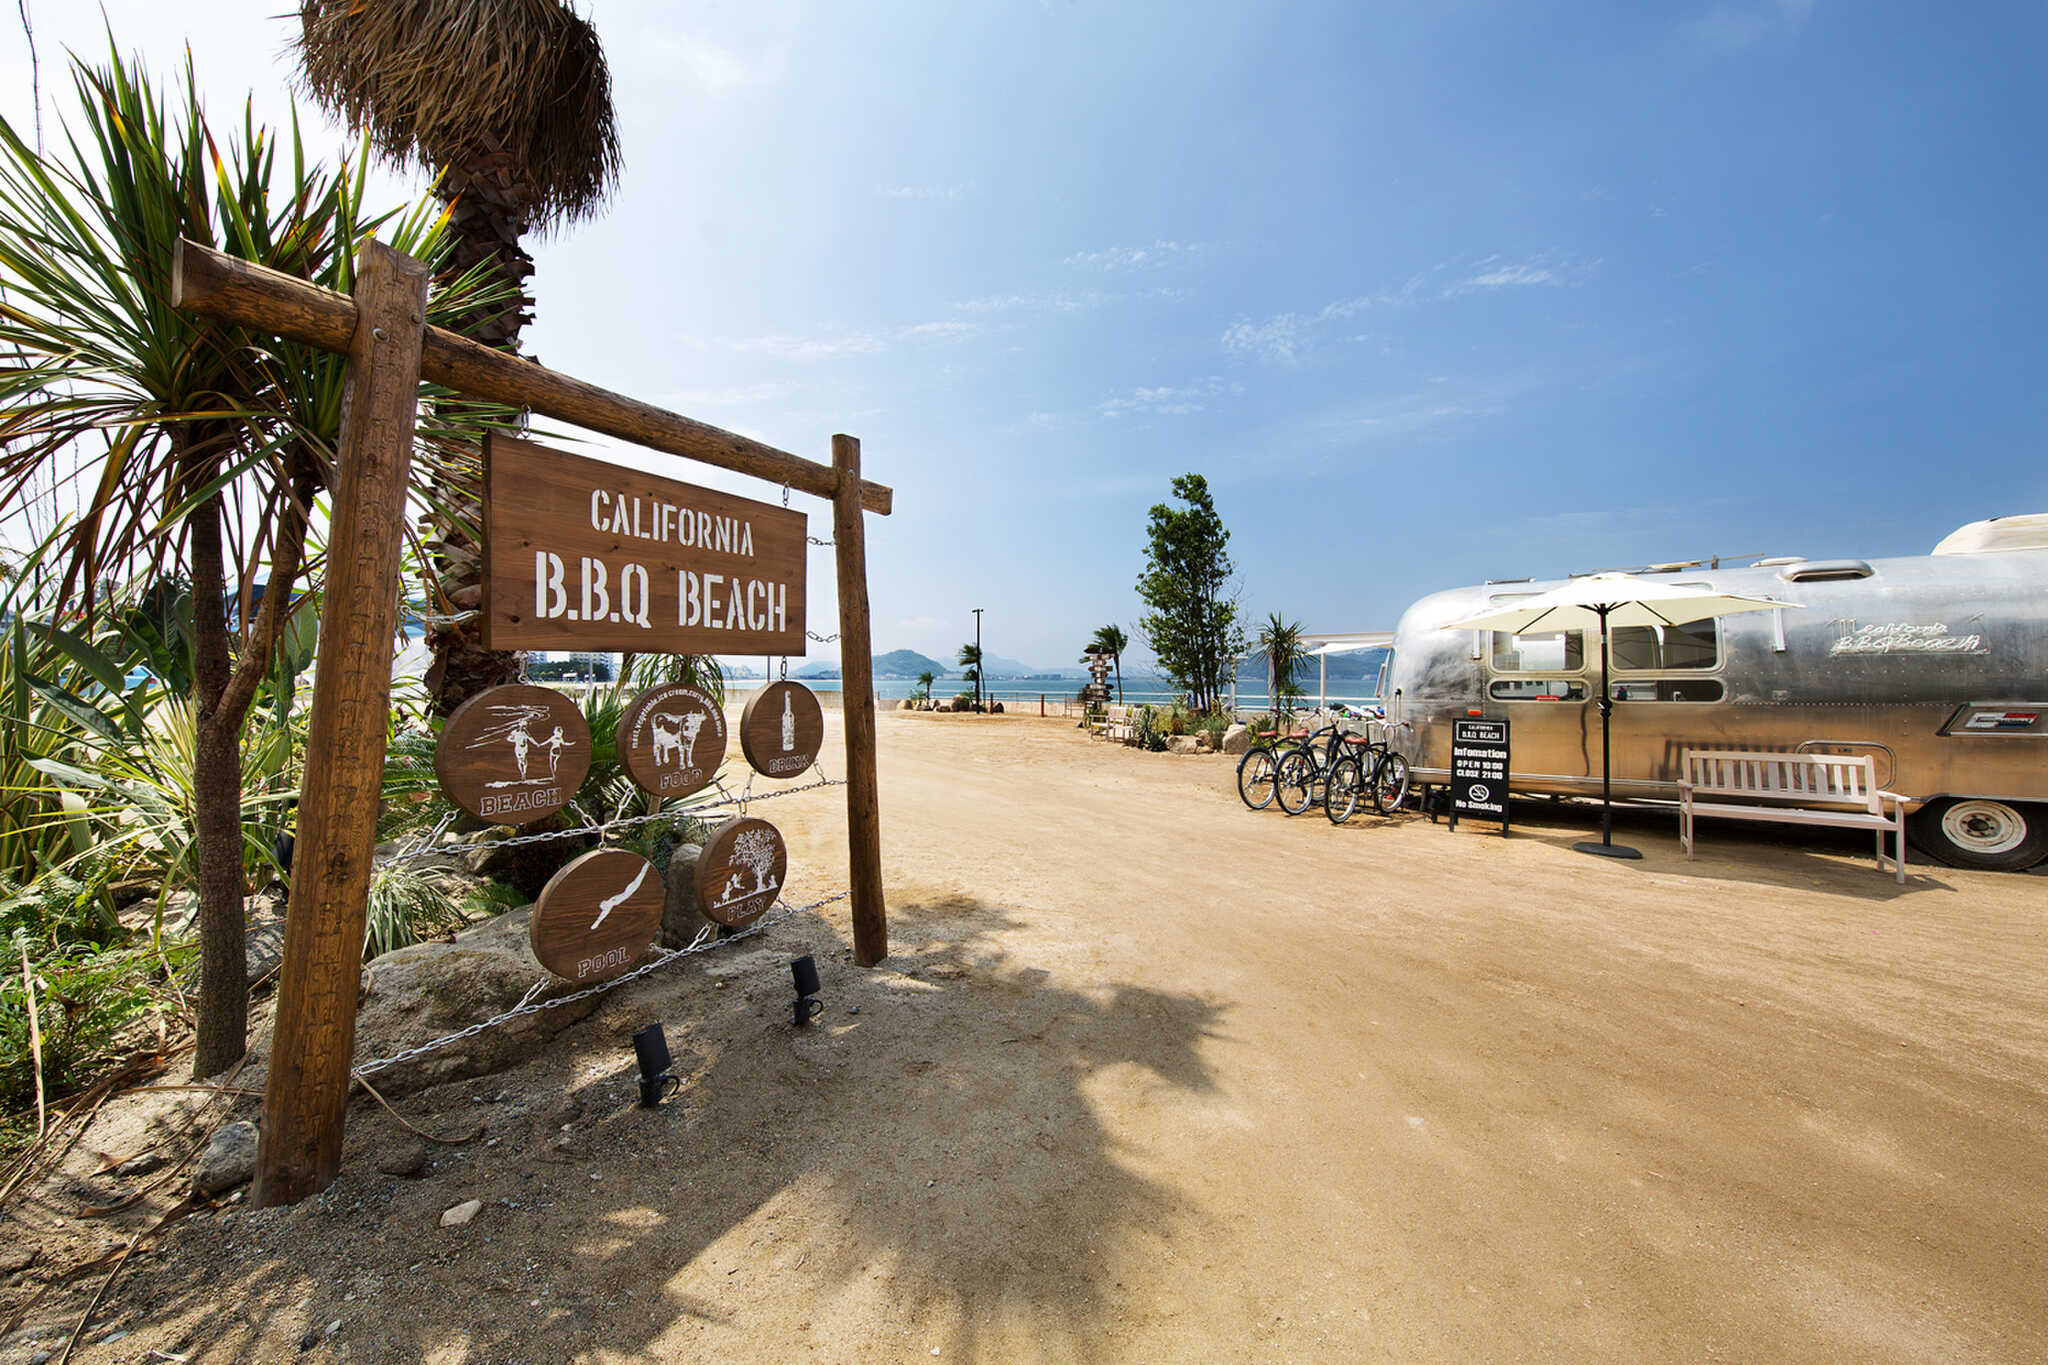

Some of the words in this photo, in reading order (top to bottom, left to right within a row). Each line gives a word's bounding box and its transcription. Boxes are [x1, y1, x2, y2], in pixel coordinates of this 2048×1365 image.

[591, 489, 754, 557] CALIFORNIA
[535, 551, 651, 628] B.B.Q
[678, 570, 786, 632] BEACH
[1479, 731, 1501, 740] BEACH
[769, 754, 810, 773] DRINK
[1456, 759, 1481, 769] OPEN
[1456, 769, 1480, 778] CLOSE
[660, 768, 703, 789] FOOD
[480, 787, 562, 816] BEACH
[1455, 800, 1467, 808] No
[1468, 801, 1503, 813] Smoking
[727, 896, 767, 922] PLAY
[577, 946, 631, 978] POOL
